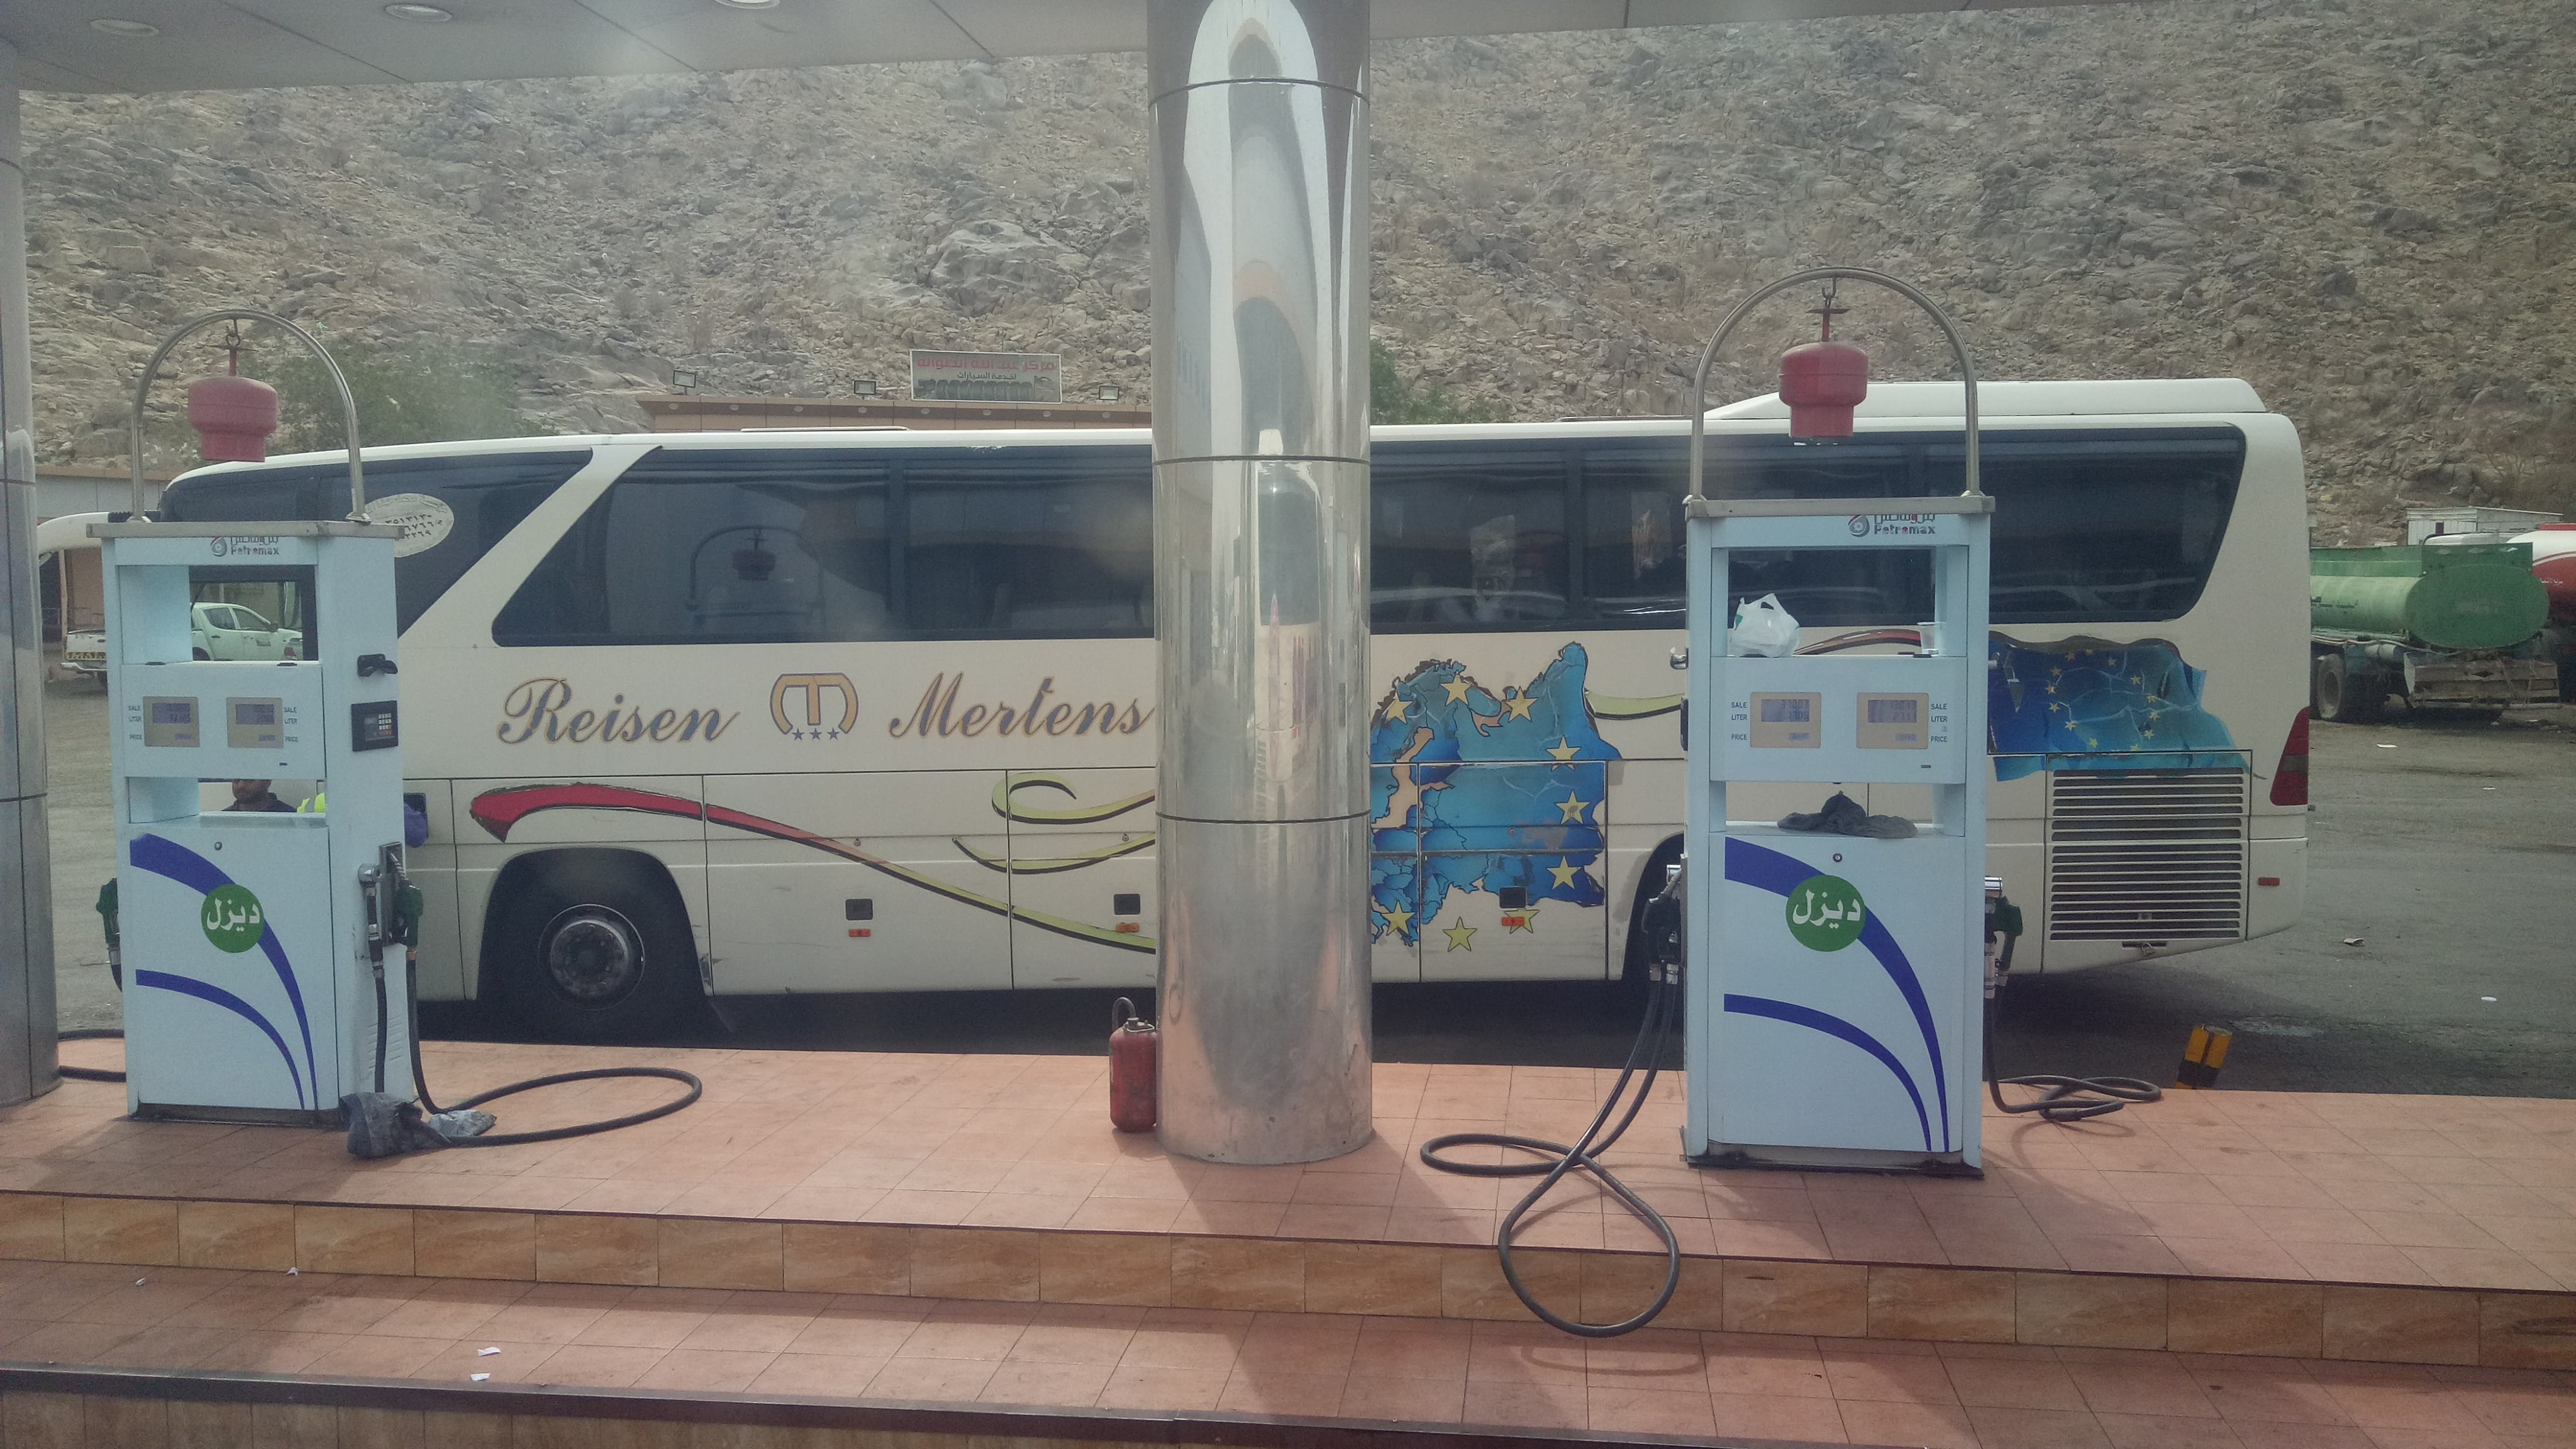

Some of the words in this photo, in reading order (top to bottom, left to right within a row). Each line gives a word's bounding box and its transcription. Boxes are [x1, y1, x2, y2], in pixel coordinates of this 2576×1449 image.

[970, 358, 994, 369] الله
[998, 362, 1018, 372] عبد
[1022, 360, 1056, 372] مركز
[957, 371, 990, 380] السيارات
[1874, 524, 1936, 535] Petromax
[231, 545, 280, 555] Petromax
[497, 675, 741, 745] Reisen
[889, 670, 1156, 740] Mertens
[206, 897, 260, 932] ديزل
[1792, 889, 1861, 930] ديزل
